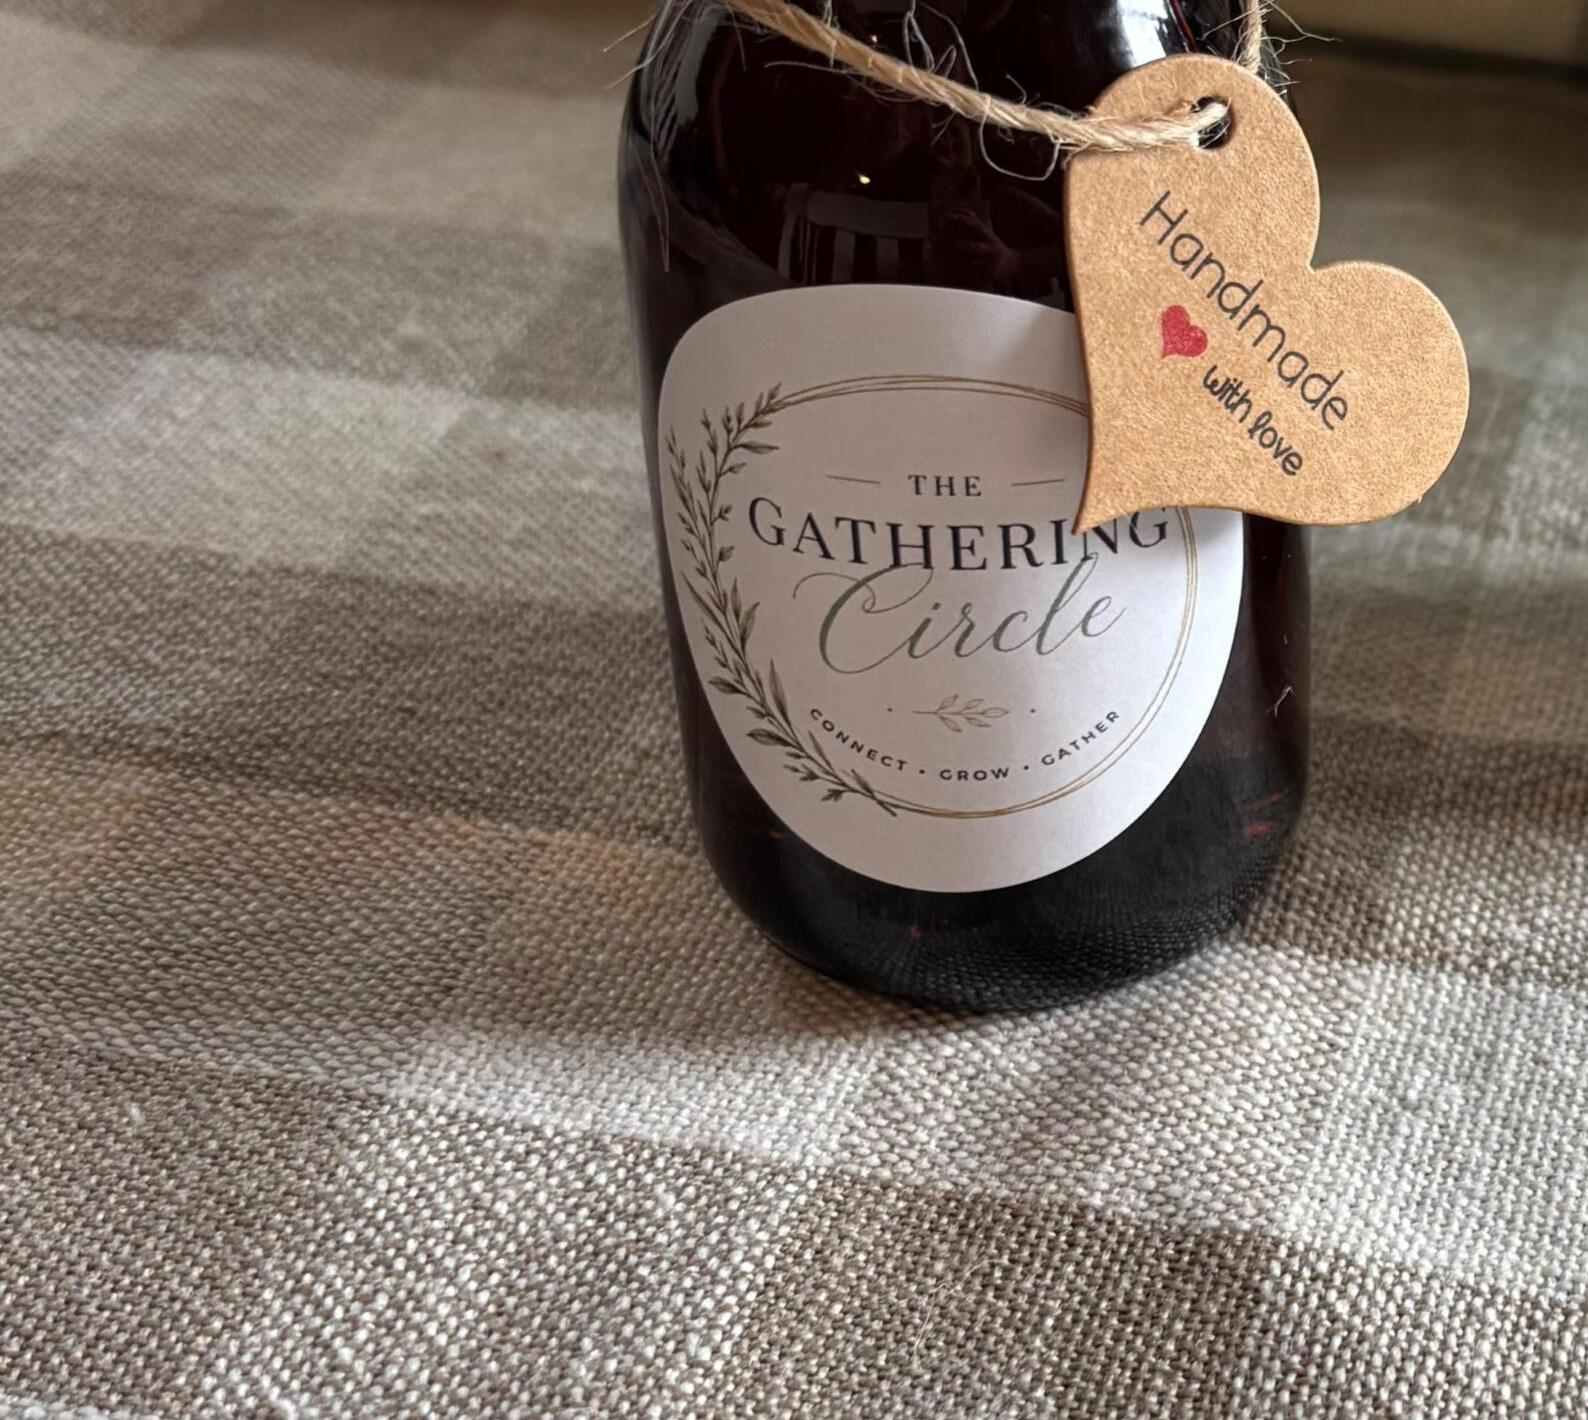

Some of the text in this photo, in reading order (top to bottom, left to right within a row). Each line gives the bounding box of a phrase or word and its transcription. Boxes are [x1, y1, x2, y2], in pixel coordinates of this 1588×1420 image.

[1139, 191, 1349, 430] Handmade
[1203, 365, 1304, 476] with love
[908, 474, 982, 498] THE
[792, 552, 1125, 674] Circle
[809, 707, 1121, 781] CONNECT GROW GATHER
